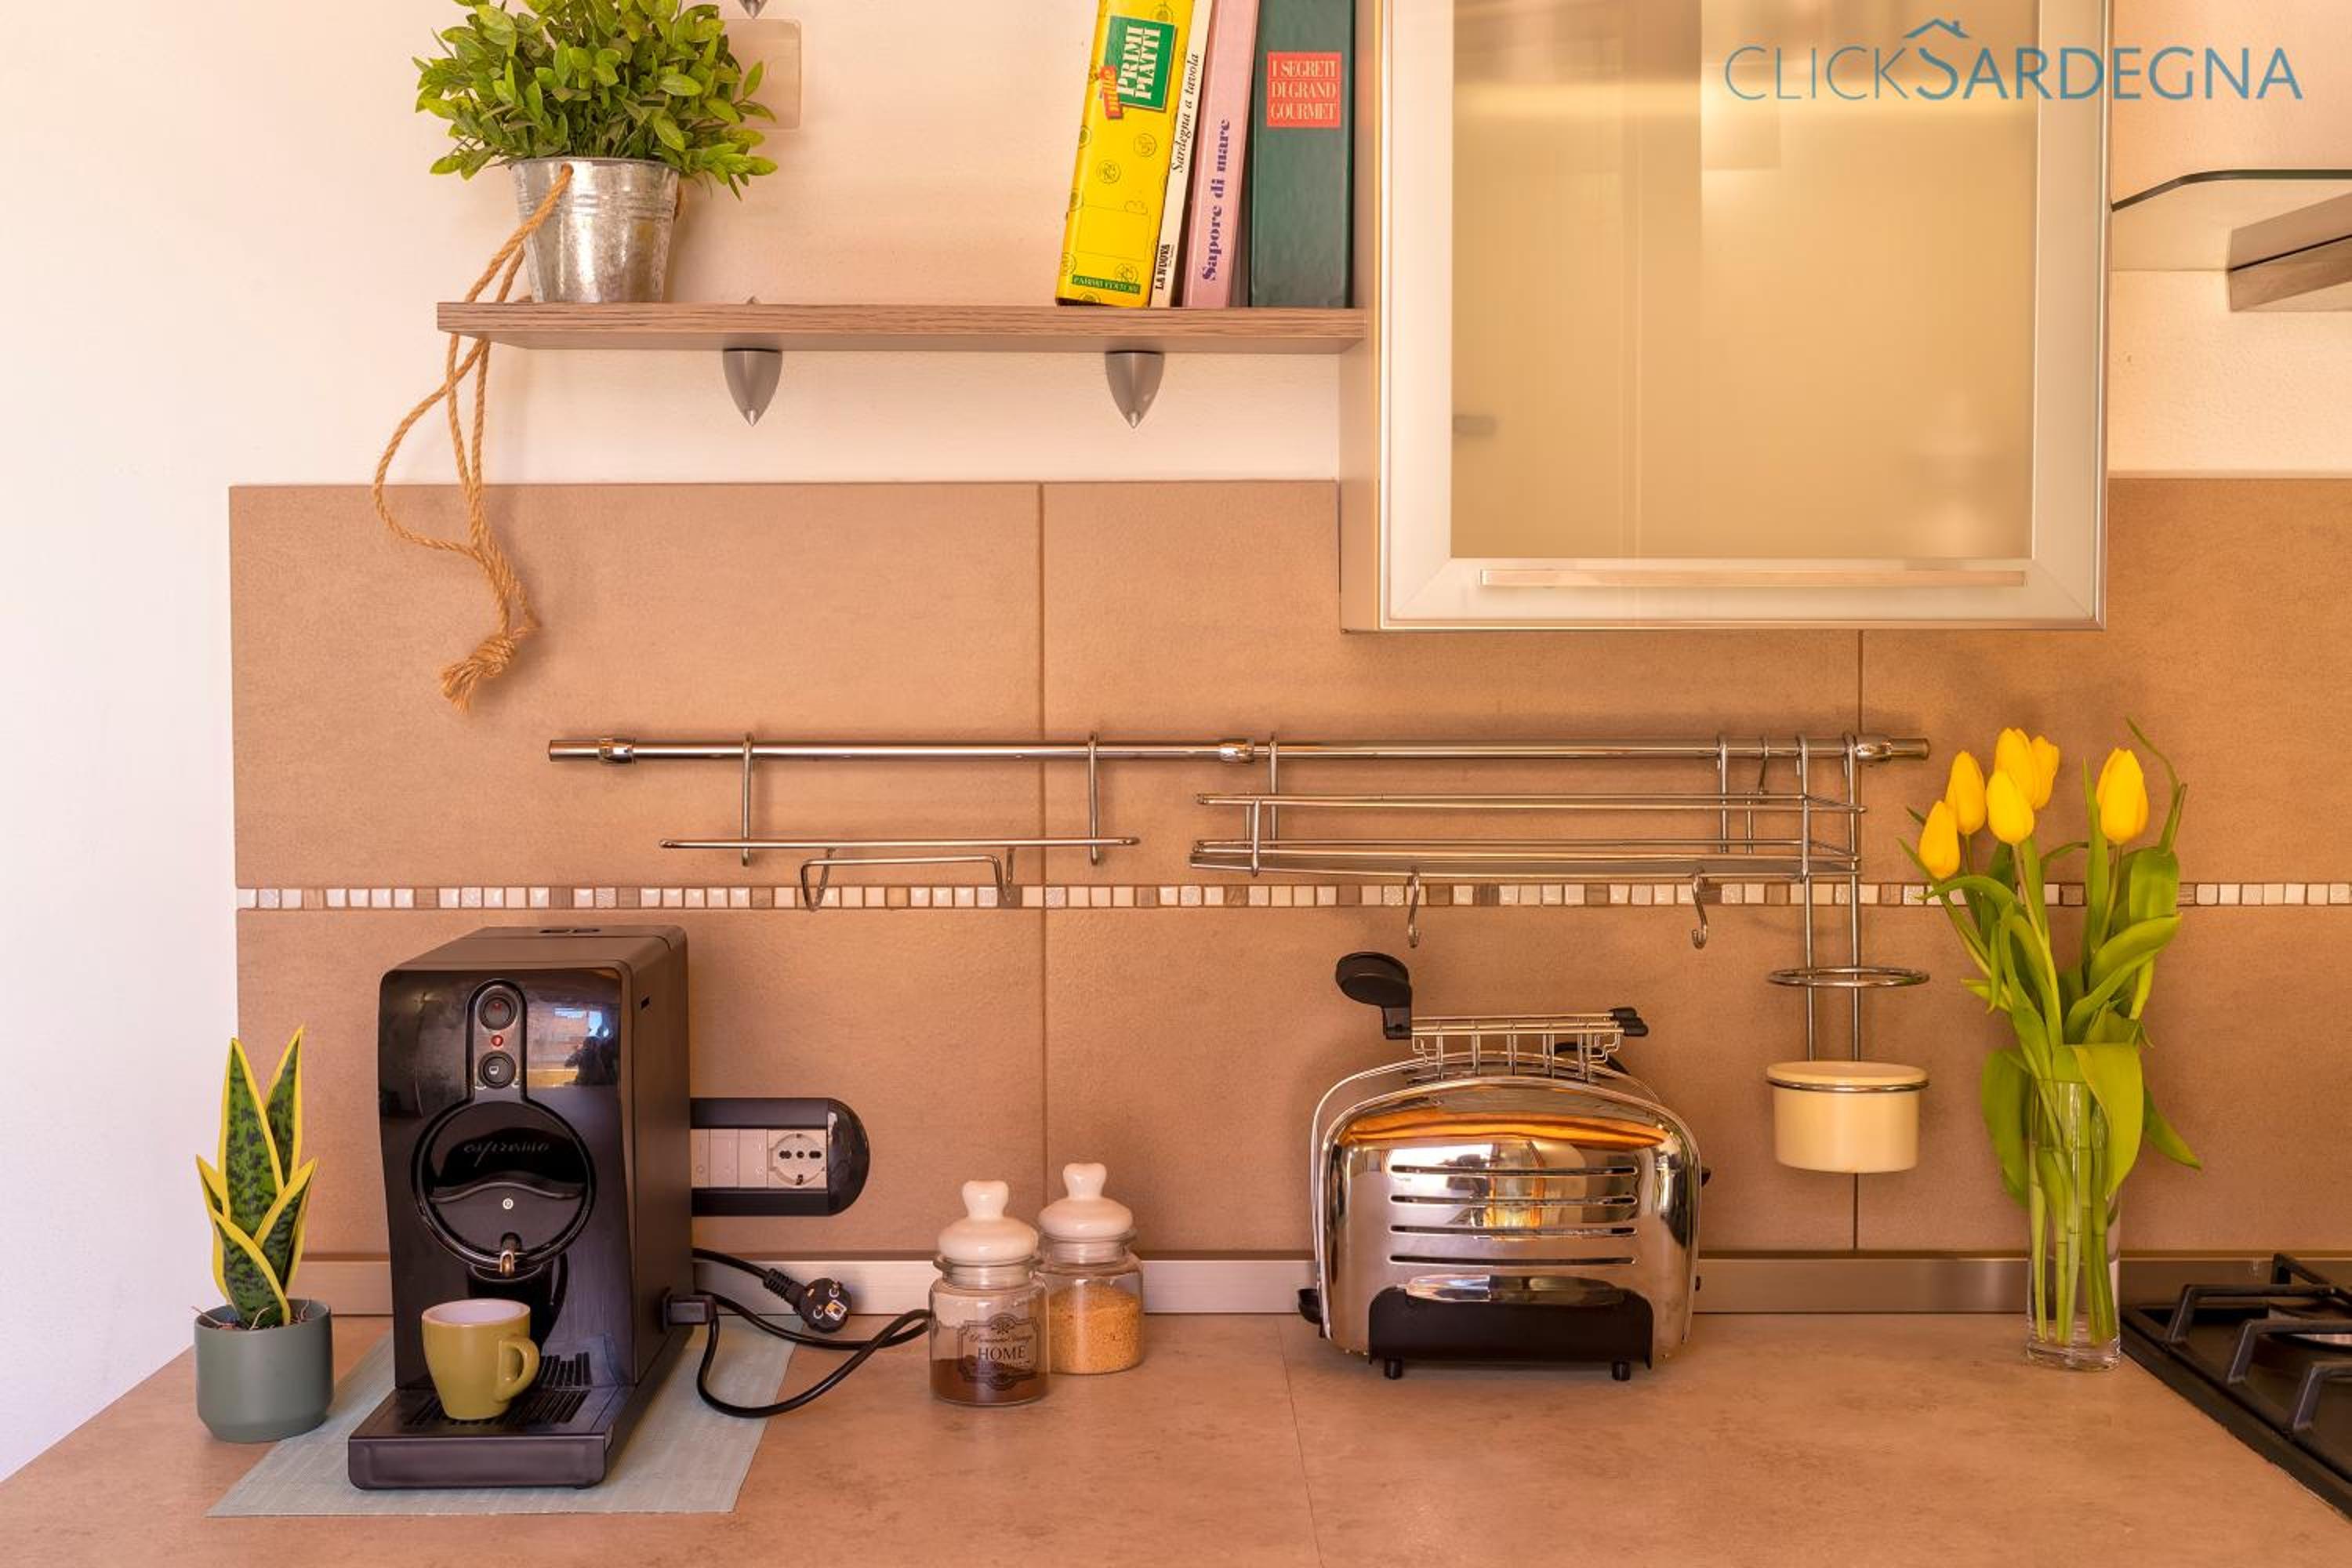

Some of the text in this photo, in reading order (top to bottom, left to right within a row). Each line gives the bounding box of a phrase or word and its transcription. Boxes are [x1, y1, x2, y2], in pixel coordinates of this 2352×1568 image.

[1116, 25, 1145, 97] PRIMI
[1134, 27, 1160, 100] PIATTI
[1272, 60, 1336, 77] I SEGRETI
[1103, 68, 1119, 111] mille
[1272, 81, 1336, 98] DI GRAND
[1171, 52, 1200, 173] Sardegna a tavola
[1271, 103, 1336, 120] GOURMET
[1203, 119, 1230, 281] Sapore di mare
[978, 1345, 1026, 1360] HOME
